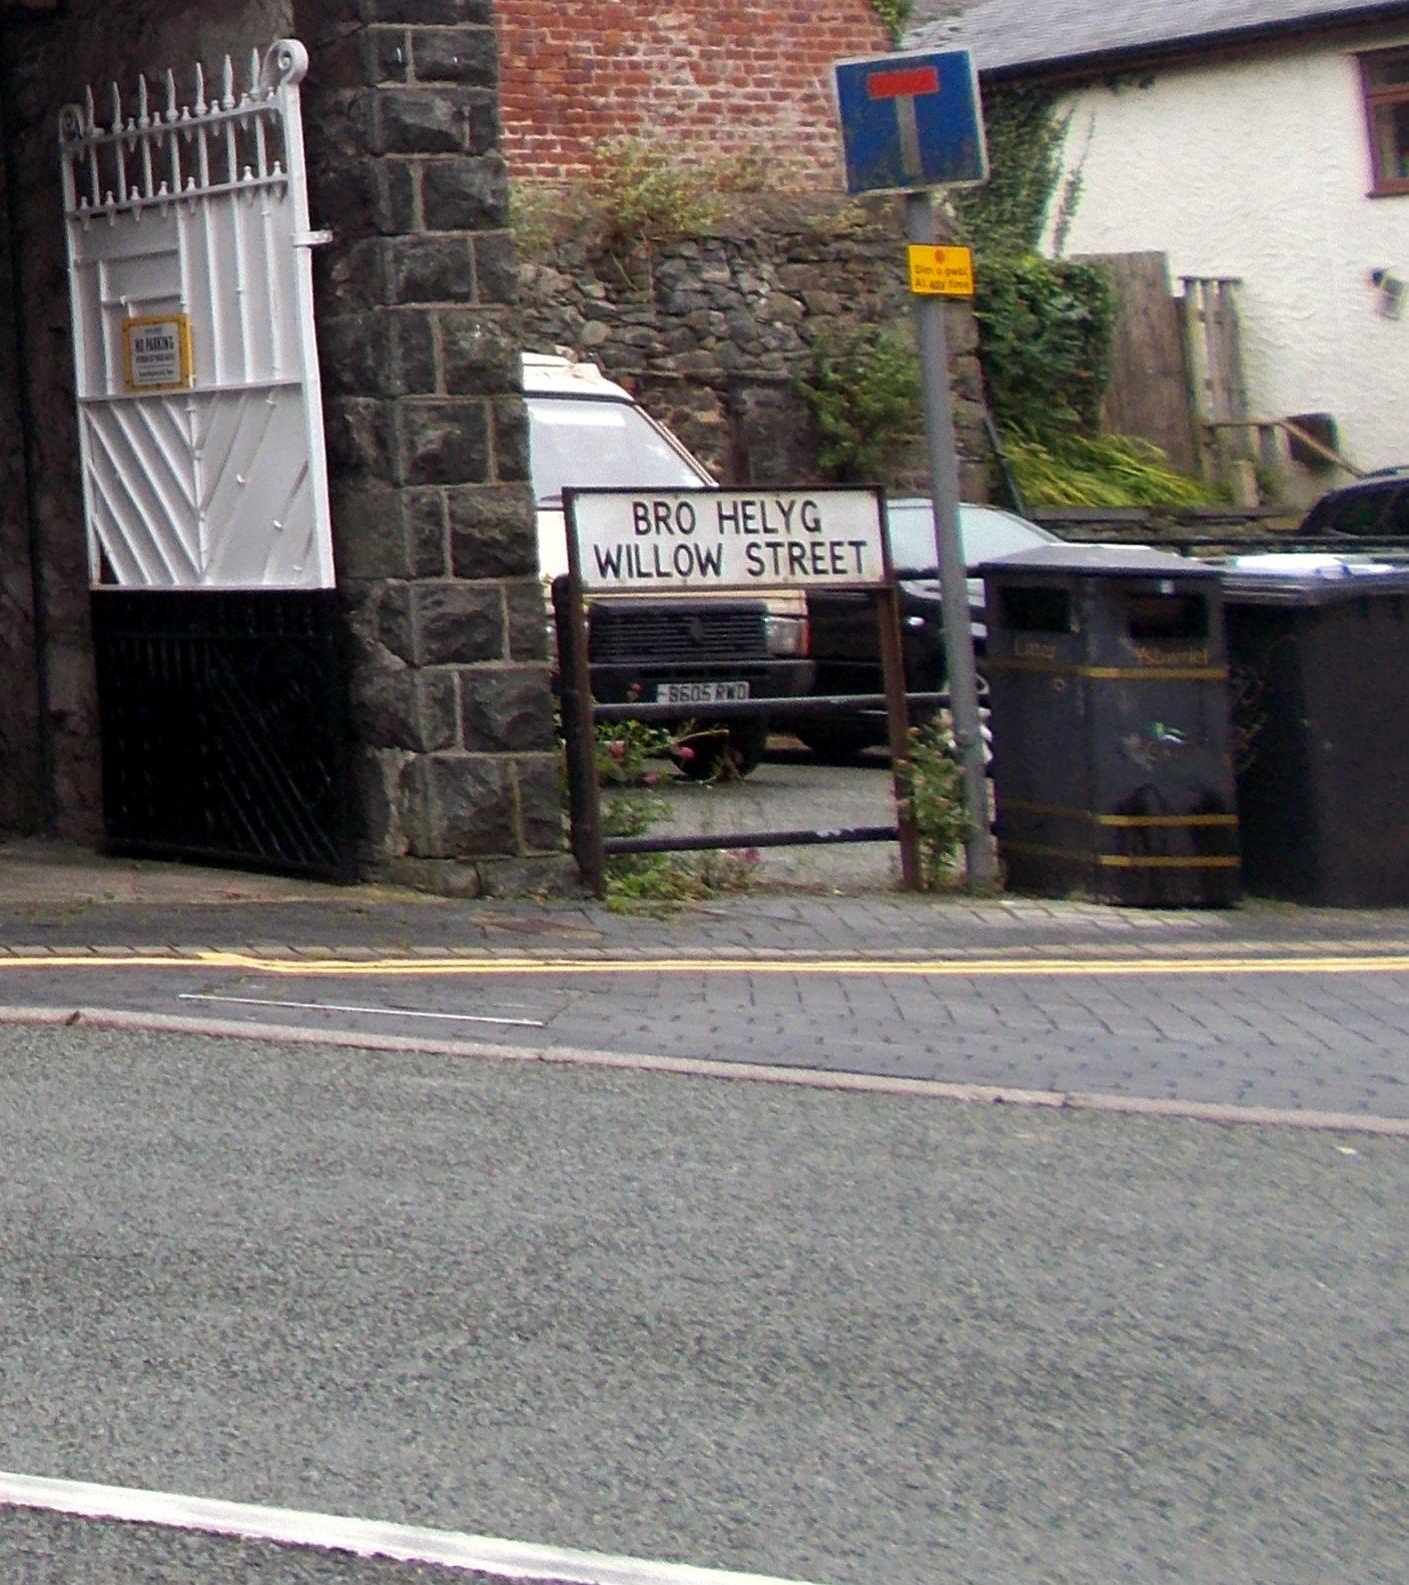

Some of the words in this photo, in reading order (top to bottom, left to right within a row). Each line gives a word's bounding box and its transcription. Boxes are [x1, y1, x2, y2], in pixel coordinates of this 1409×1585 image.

[146, 336, 174, 352] PARKING
[632, 500, 697, 536] BRO
[717, 499, 823, 535] HELYG
[593, 543, 723, 579] WILLOW
[745, 540, 869, 576] STREET
